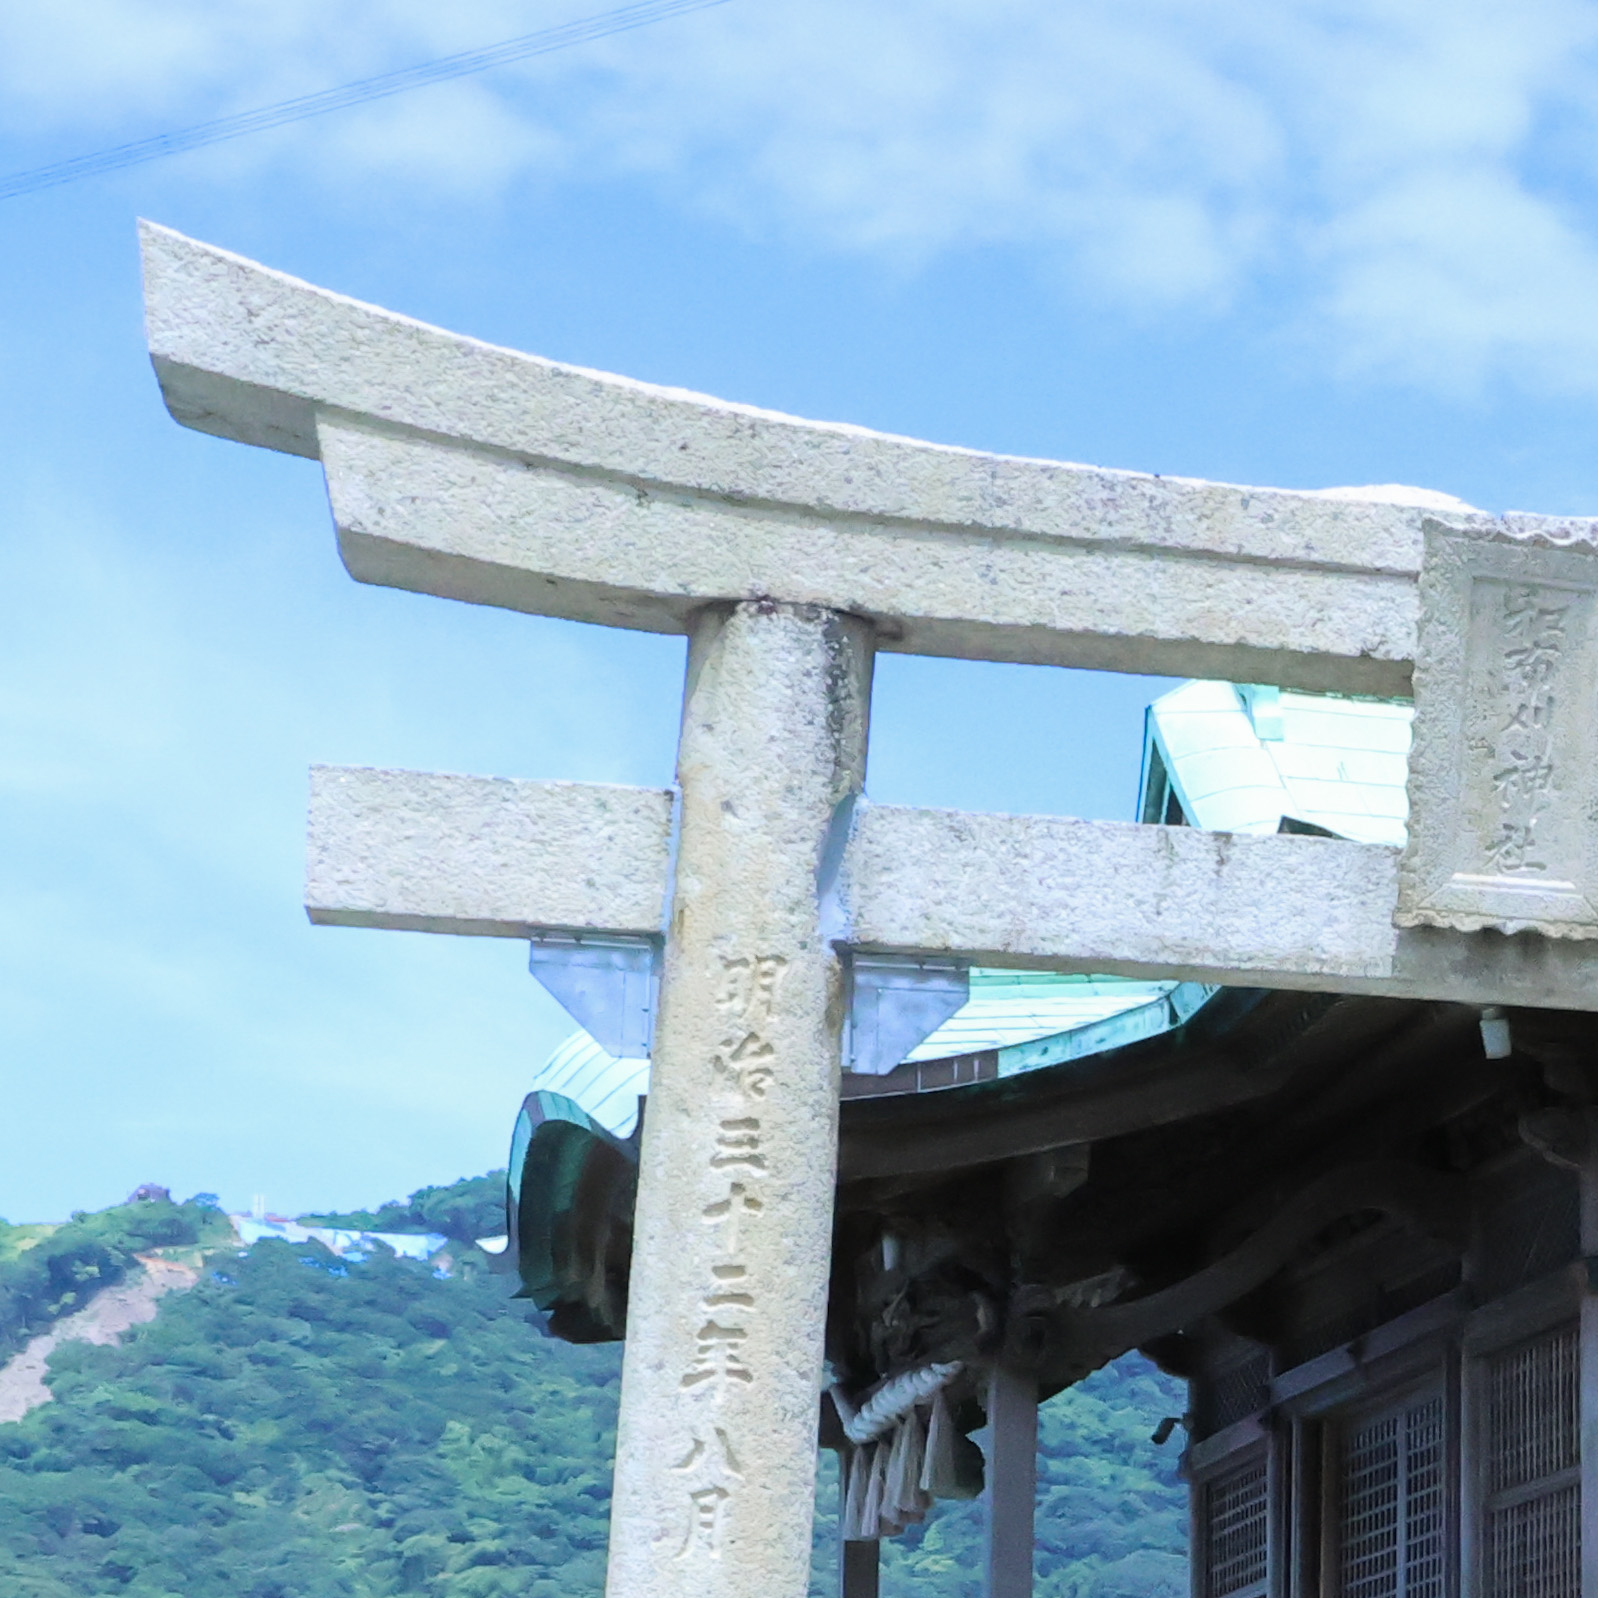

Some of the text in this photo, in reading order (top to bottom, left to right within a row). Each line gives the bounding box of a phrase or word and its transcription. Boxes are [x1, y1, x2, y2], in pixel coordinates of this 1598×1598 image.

[1484, 586, 1569, 872] 和布刈神社
[669, 953, 788, 1561] 明治三十二年八月
